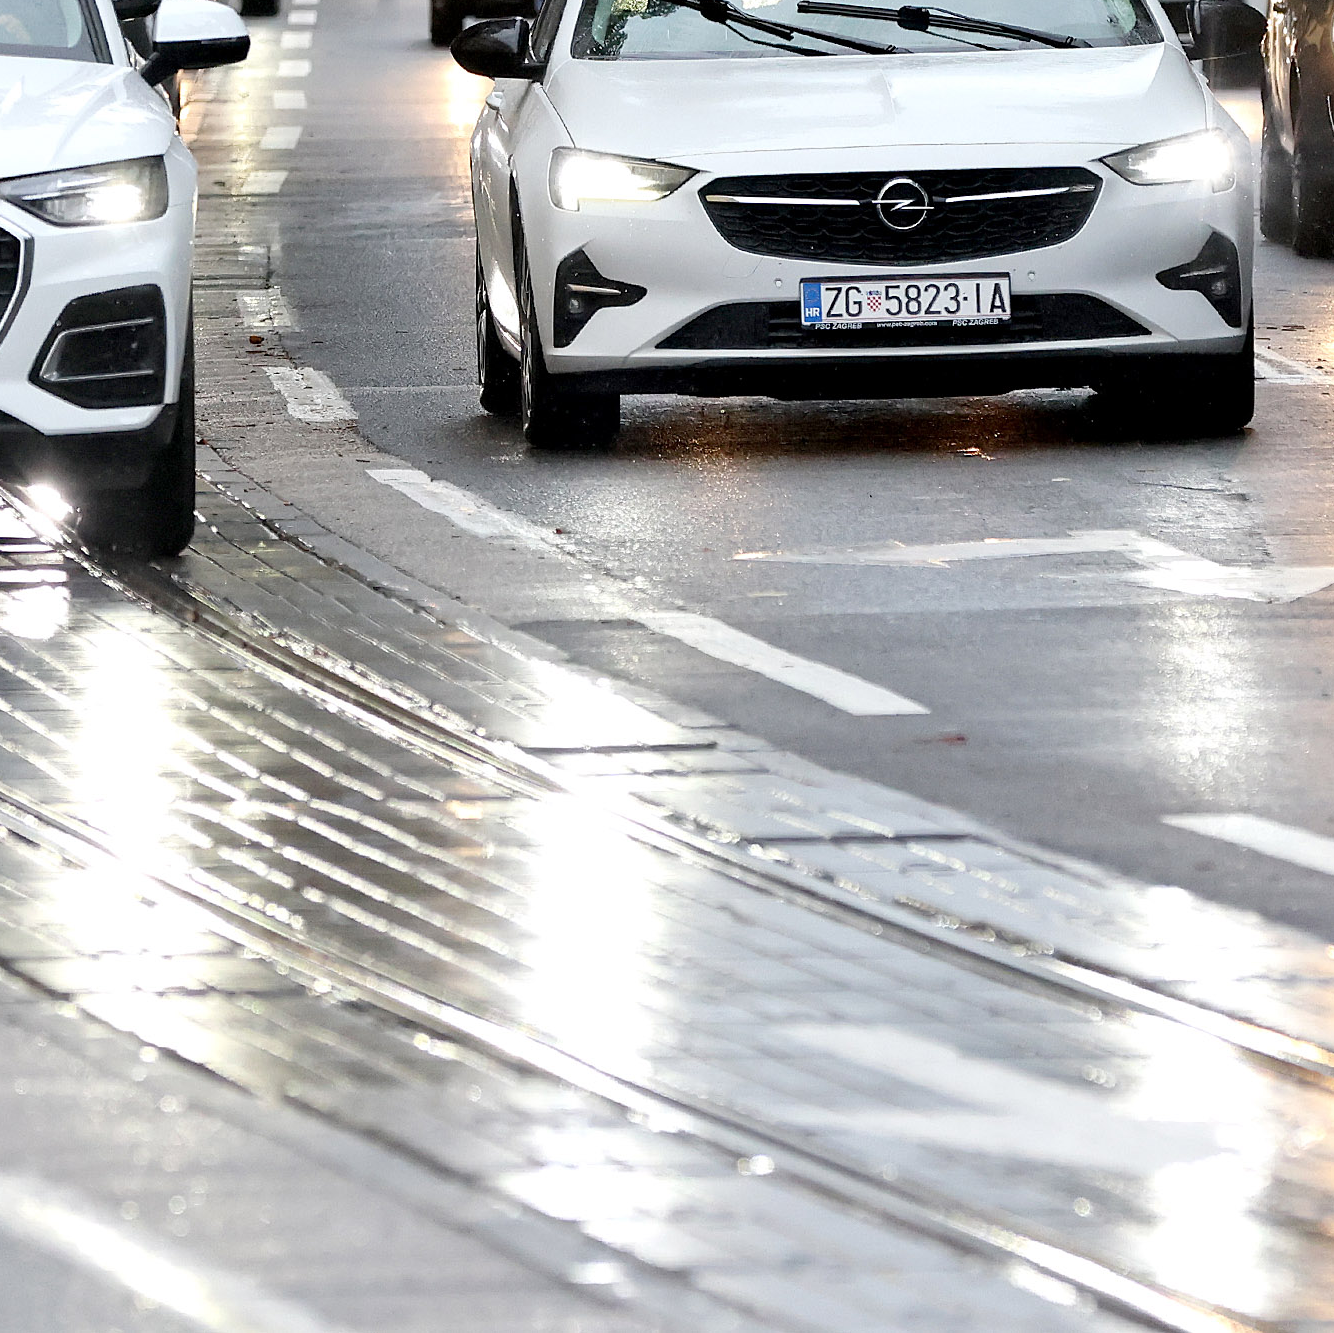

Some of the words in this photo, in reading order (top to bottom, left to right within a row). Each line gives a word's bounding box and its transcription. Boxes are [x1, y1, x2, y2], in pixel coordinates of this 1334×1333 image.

[805, 307, 820, 318] HR
[825, 286, 863, 318] ZG
[832, 322, 863, 330] ZAGREB
